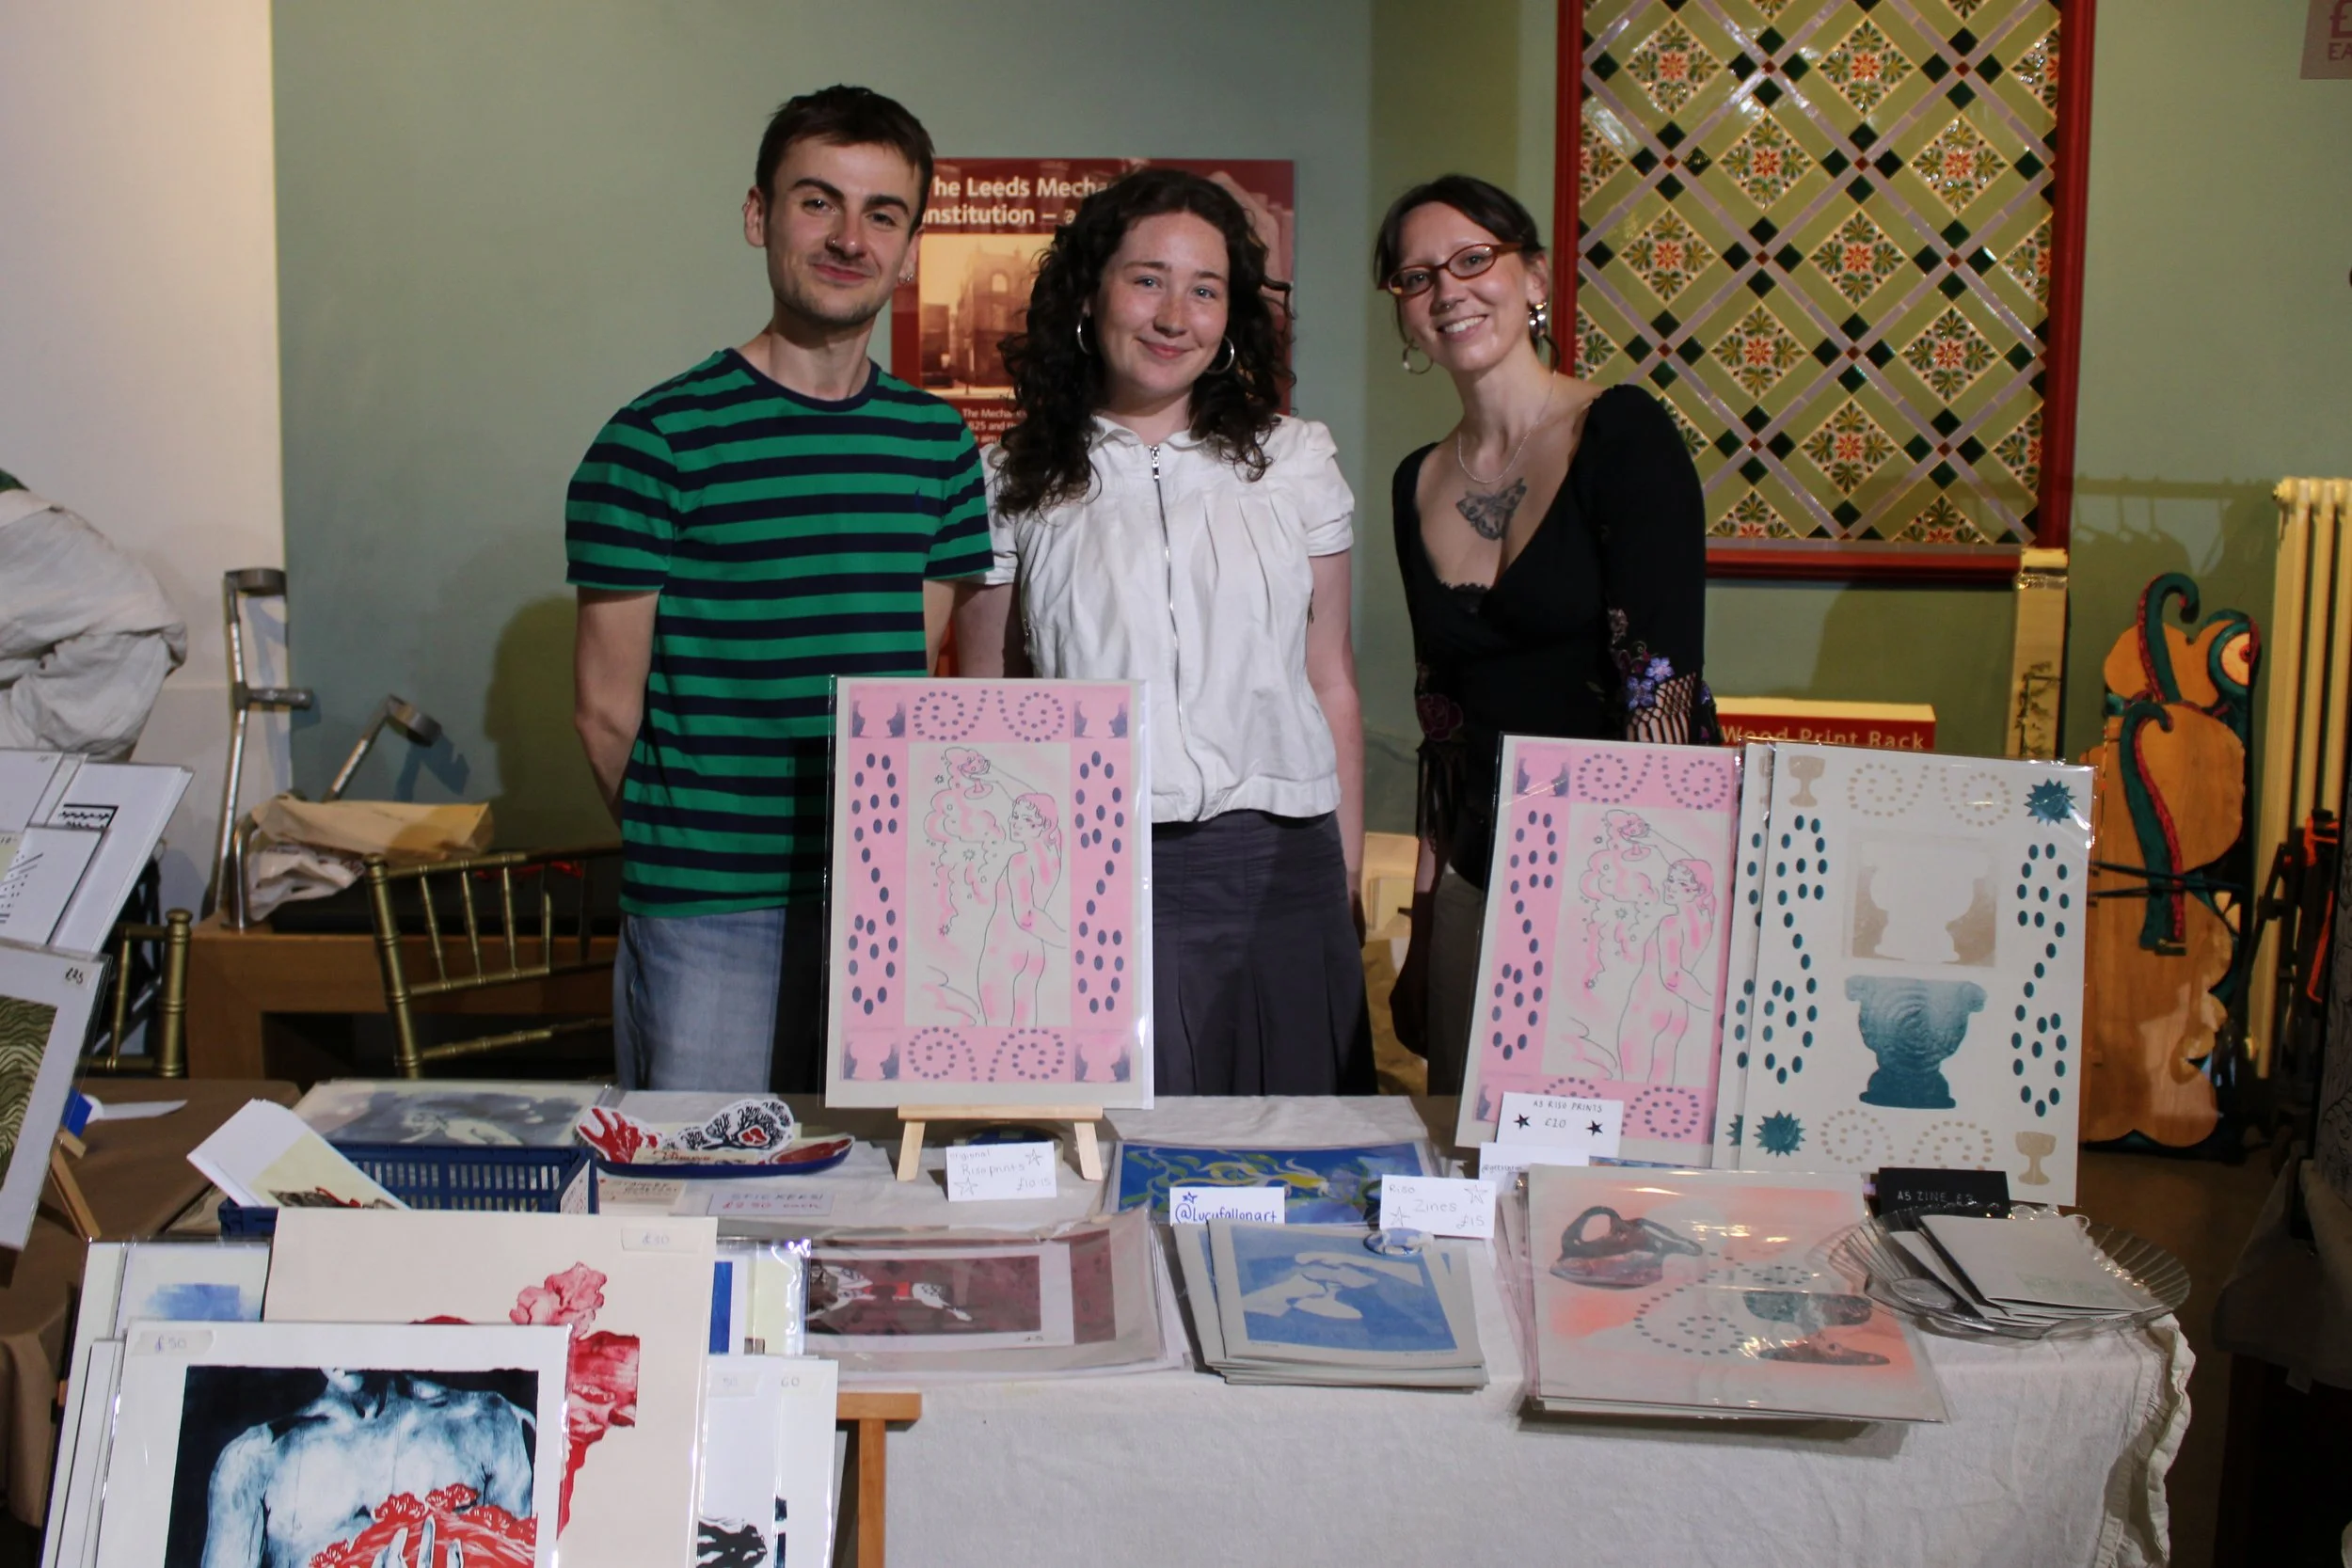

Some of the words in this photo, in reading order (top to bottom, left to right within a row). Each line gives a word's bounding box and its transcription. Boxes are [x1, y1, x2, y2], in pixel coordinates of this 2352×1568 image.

[933, 175, 961, 197] he
[967, 176, 1030, 197] Leeds
[962, 408, 978, 418] The
[1800, 728, 1858, 745] Print
[1868, 730, 1924, 751] Rack
[1571, 1101, 1603, 1114] PRINTS
[1916, 1191, 1947, 1203] ZINE
